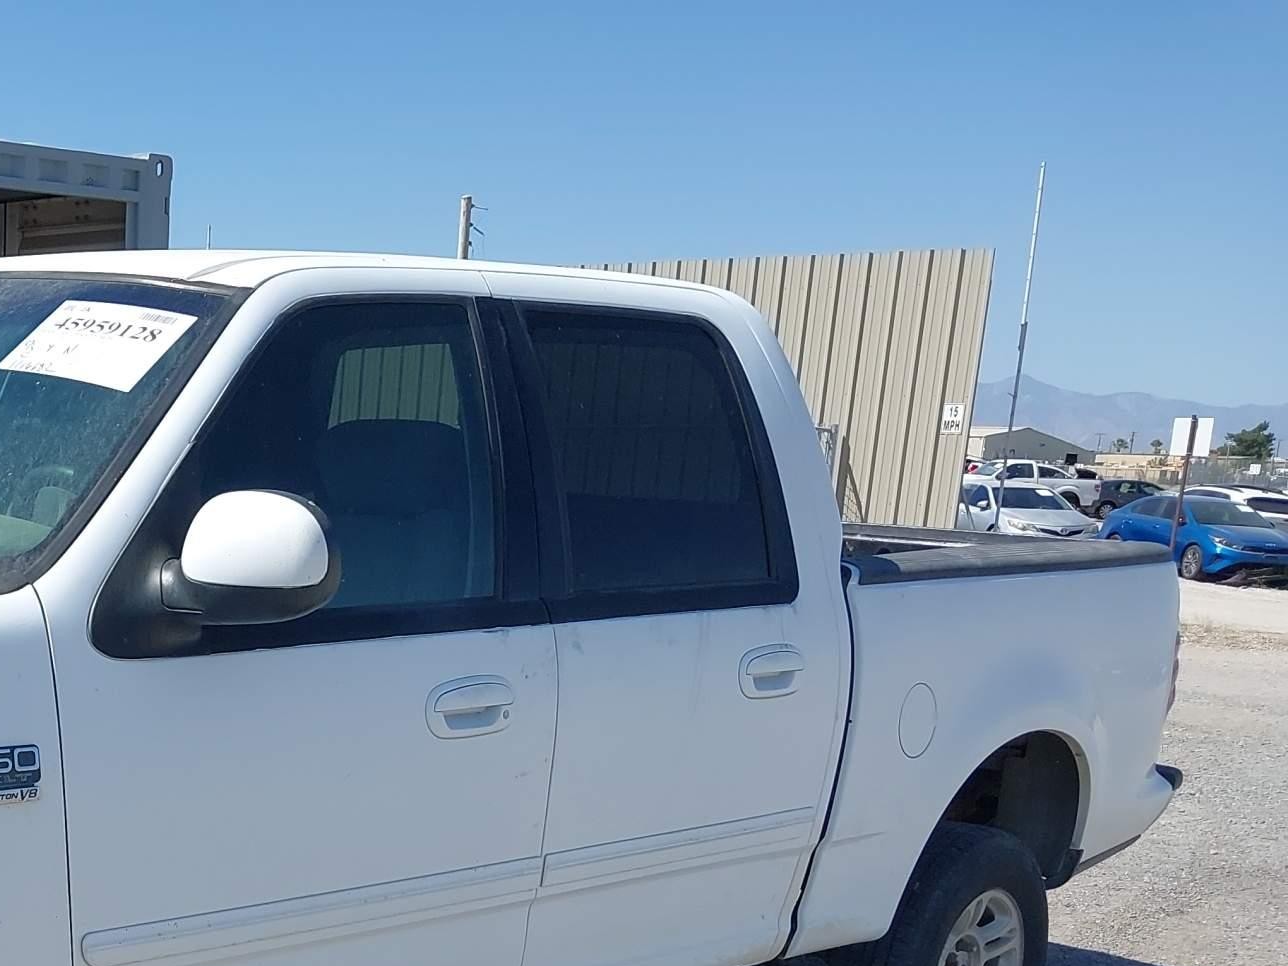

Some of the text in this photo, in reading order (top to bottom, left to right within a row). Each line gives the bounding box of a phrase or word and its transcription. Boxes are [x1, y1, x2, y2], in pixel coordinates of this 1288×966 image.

[54, 316, 162, 343] 45959128
[949, 406, 959, 418] 15
[943, 420, 961, 431] MPH
[20, 788, 38, 801] V8
